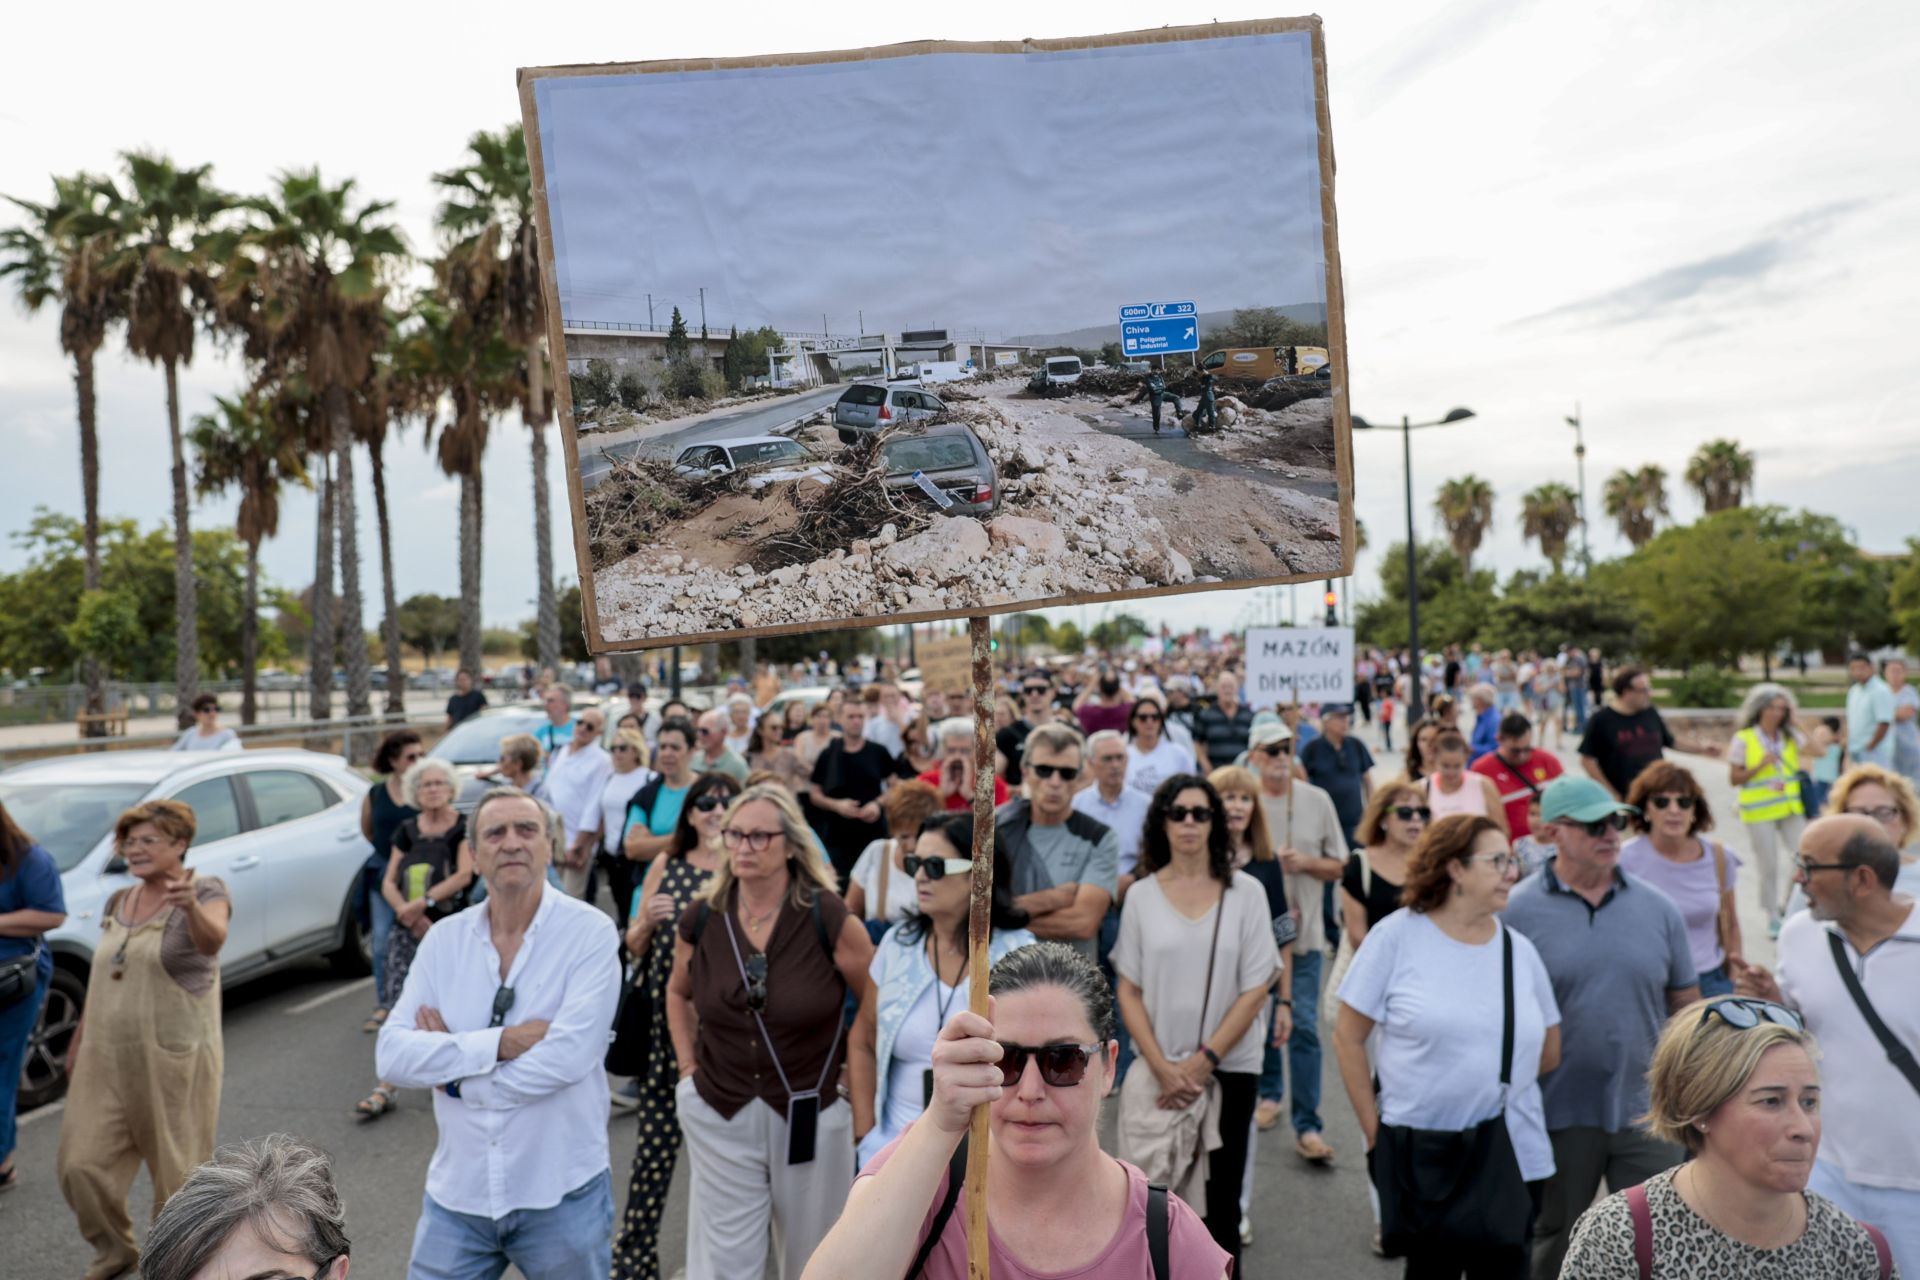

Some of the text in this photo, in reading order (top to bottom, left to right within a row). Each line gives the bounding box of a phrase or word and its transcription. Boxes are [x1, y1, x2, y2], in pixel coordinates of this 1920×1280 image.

[1177, 304, 1191, 312] 322
[1125, 326, 1150, 334] Chiva
[1263, 636, 1340, 657] MAZÓN
[1258, 669, 1343, 691] DIMISSIÓ
